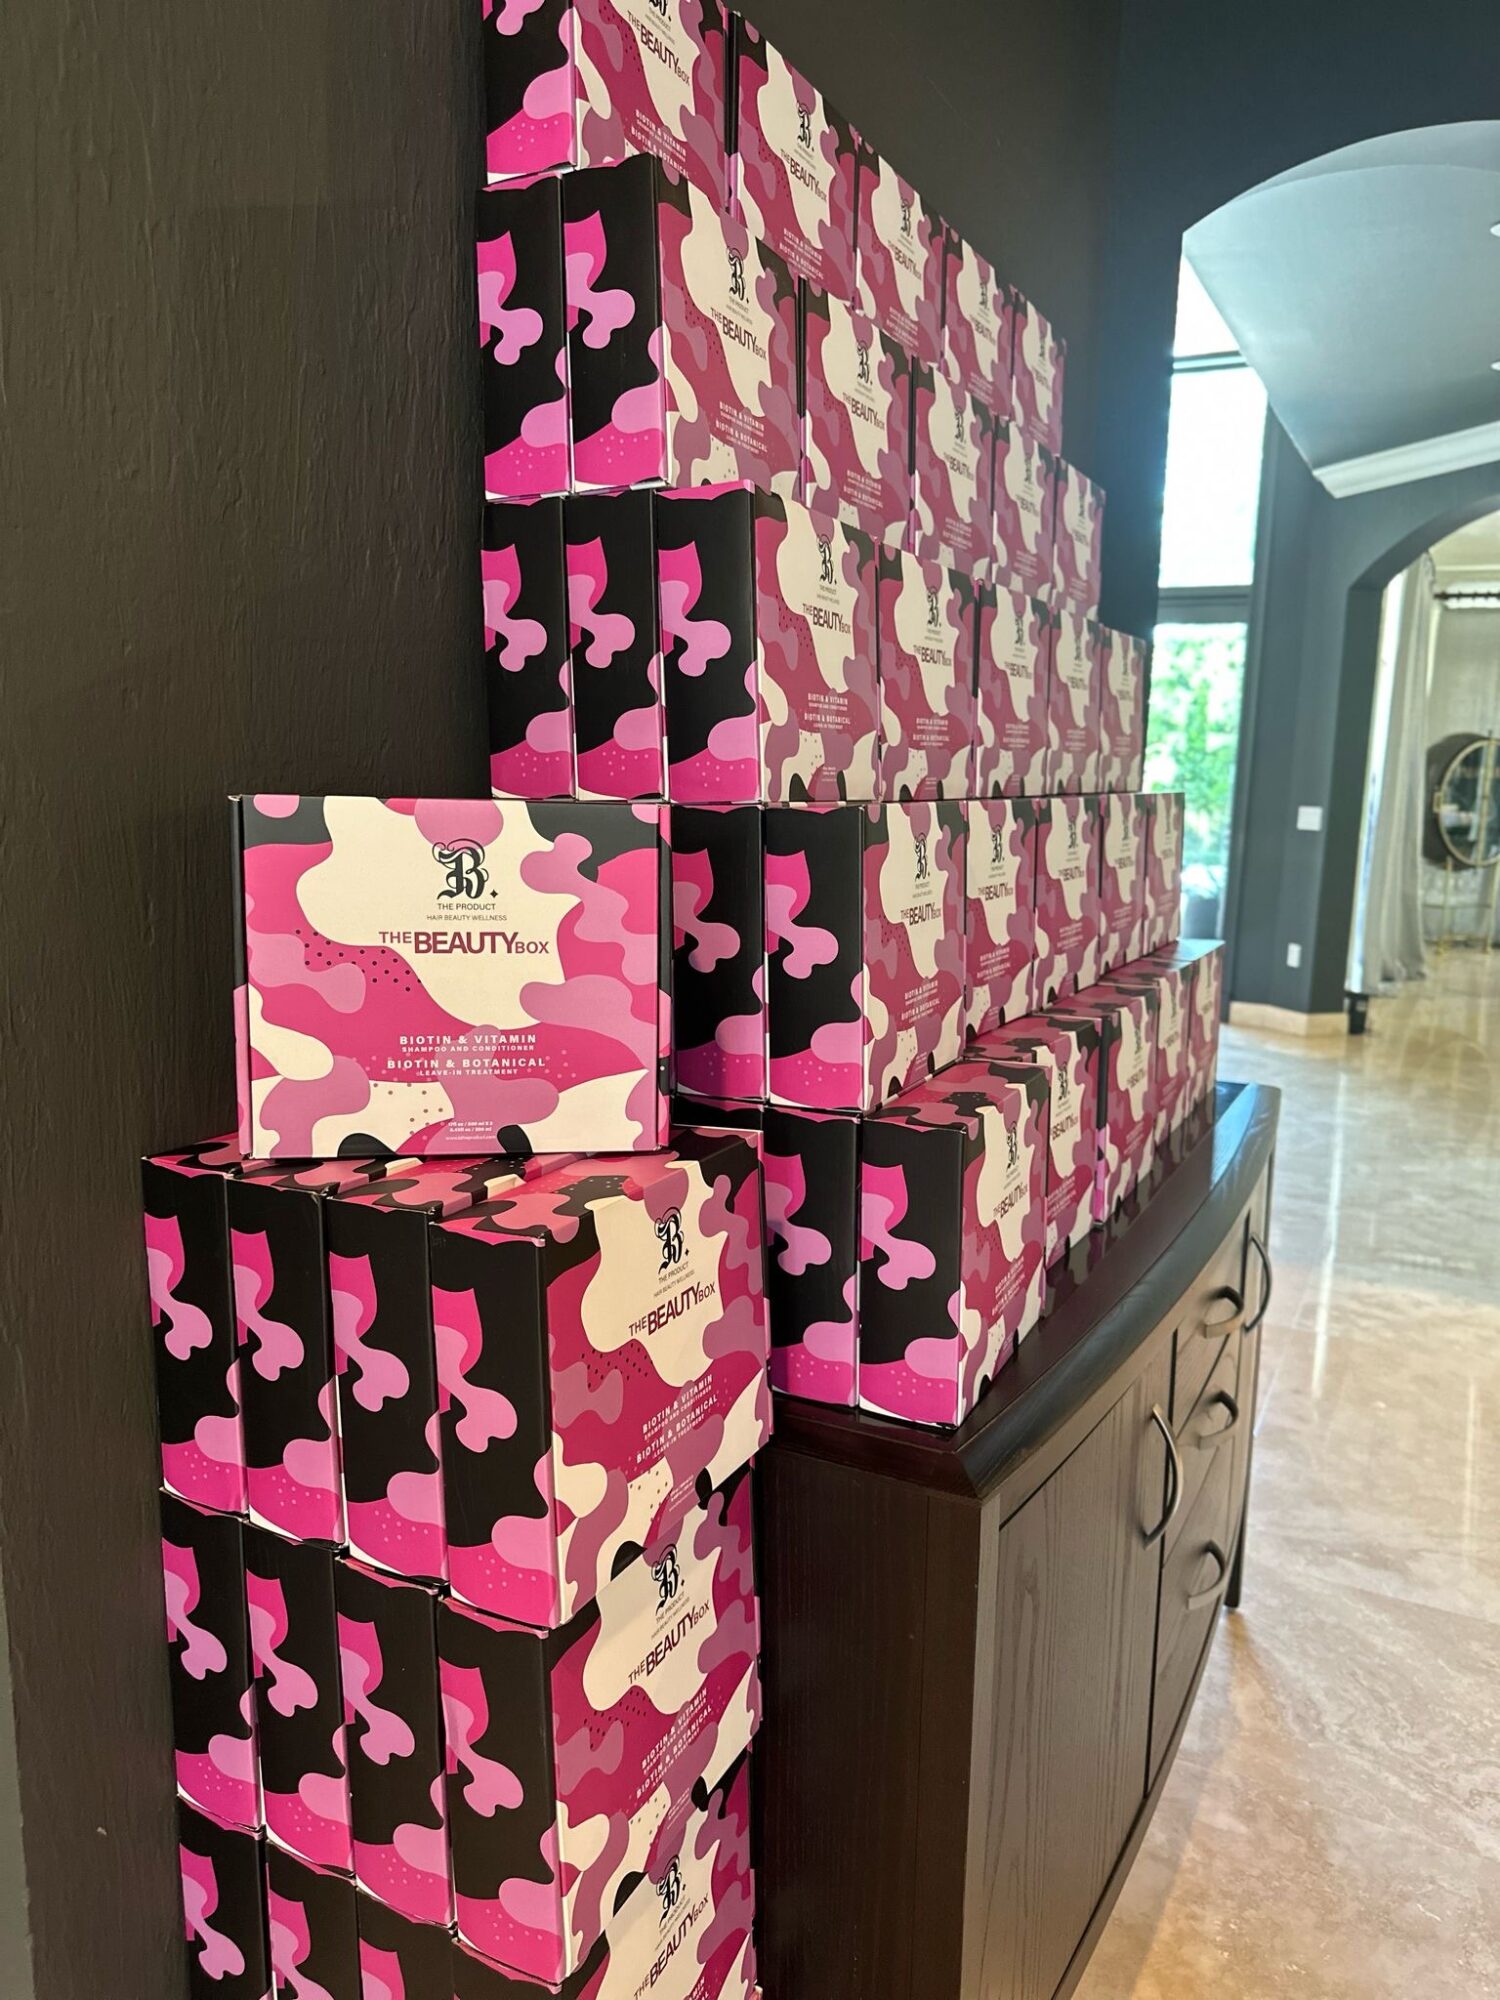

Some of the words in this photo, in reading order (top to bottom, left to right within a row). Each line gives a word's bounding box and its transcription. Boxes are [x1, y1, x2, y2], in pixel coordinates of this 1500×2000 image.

[387, 1060, 439, 1069] BIOTIN
[446, 1059, 455, 1068] &
[462, 1058, 545, 1067] BOTANICAL
[400, 1036, 451, 1045] BIOTIN
[458, 1036, 467, 1044] &
[474, 1035, 536, 1043] VITAMIN
[659, 1273, 668, 1284] THE
[668, 1262, 689, 1278] PRODUCT
[636, 1434, 664, 1464] BIOTIN
[667, 1430, 672, 1439] &
[676, 1394, 717, 1432] BOTANICAL
[642, 1406, 670, 1434] BIOTIN
[673, 1400, 679, 1410] &
[682, 1374, 712, 1403] VITAMIN
[637, 1762, 662, 1799] BIOTIN
[673, 1704, 712, 1755] BOTANICAL
[642, 1734, 668, 1769] BIOTIN
[678, 1687, 707, 1725] VITAMIN
